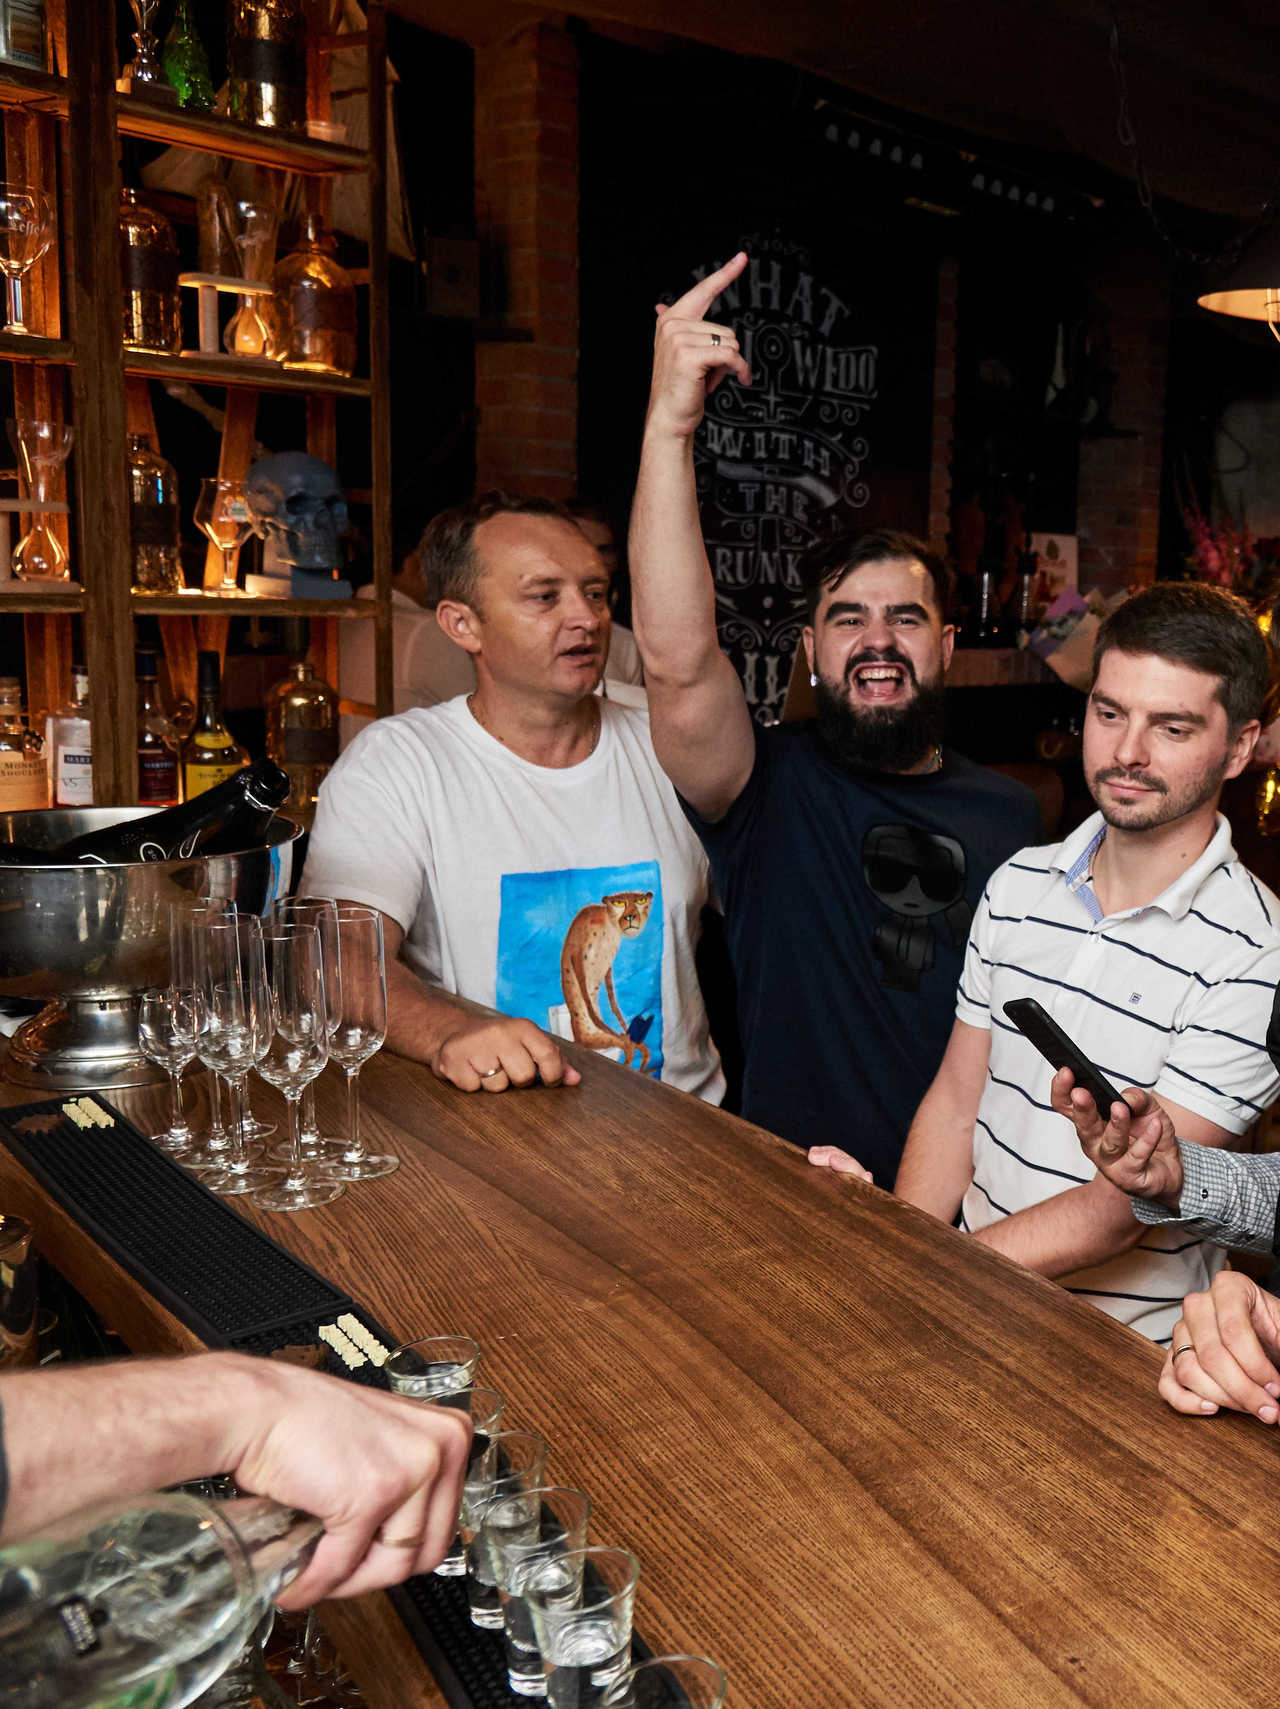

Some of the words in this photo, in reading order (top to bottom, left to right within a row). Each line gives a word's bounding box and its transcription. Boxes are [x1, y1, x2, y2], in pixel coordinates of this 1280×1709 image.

[706, 420, 832, 477] WITH
[738, 481, 809, 524] THE
[714, 547, 804, 587] RUNK
